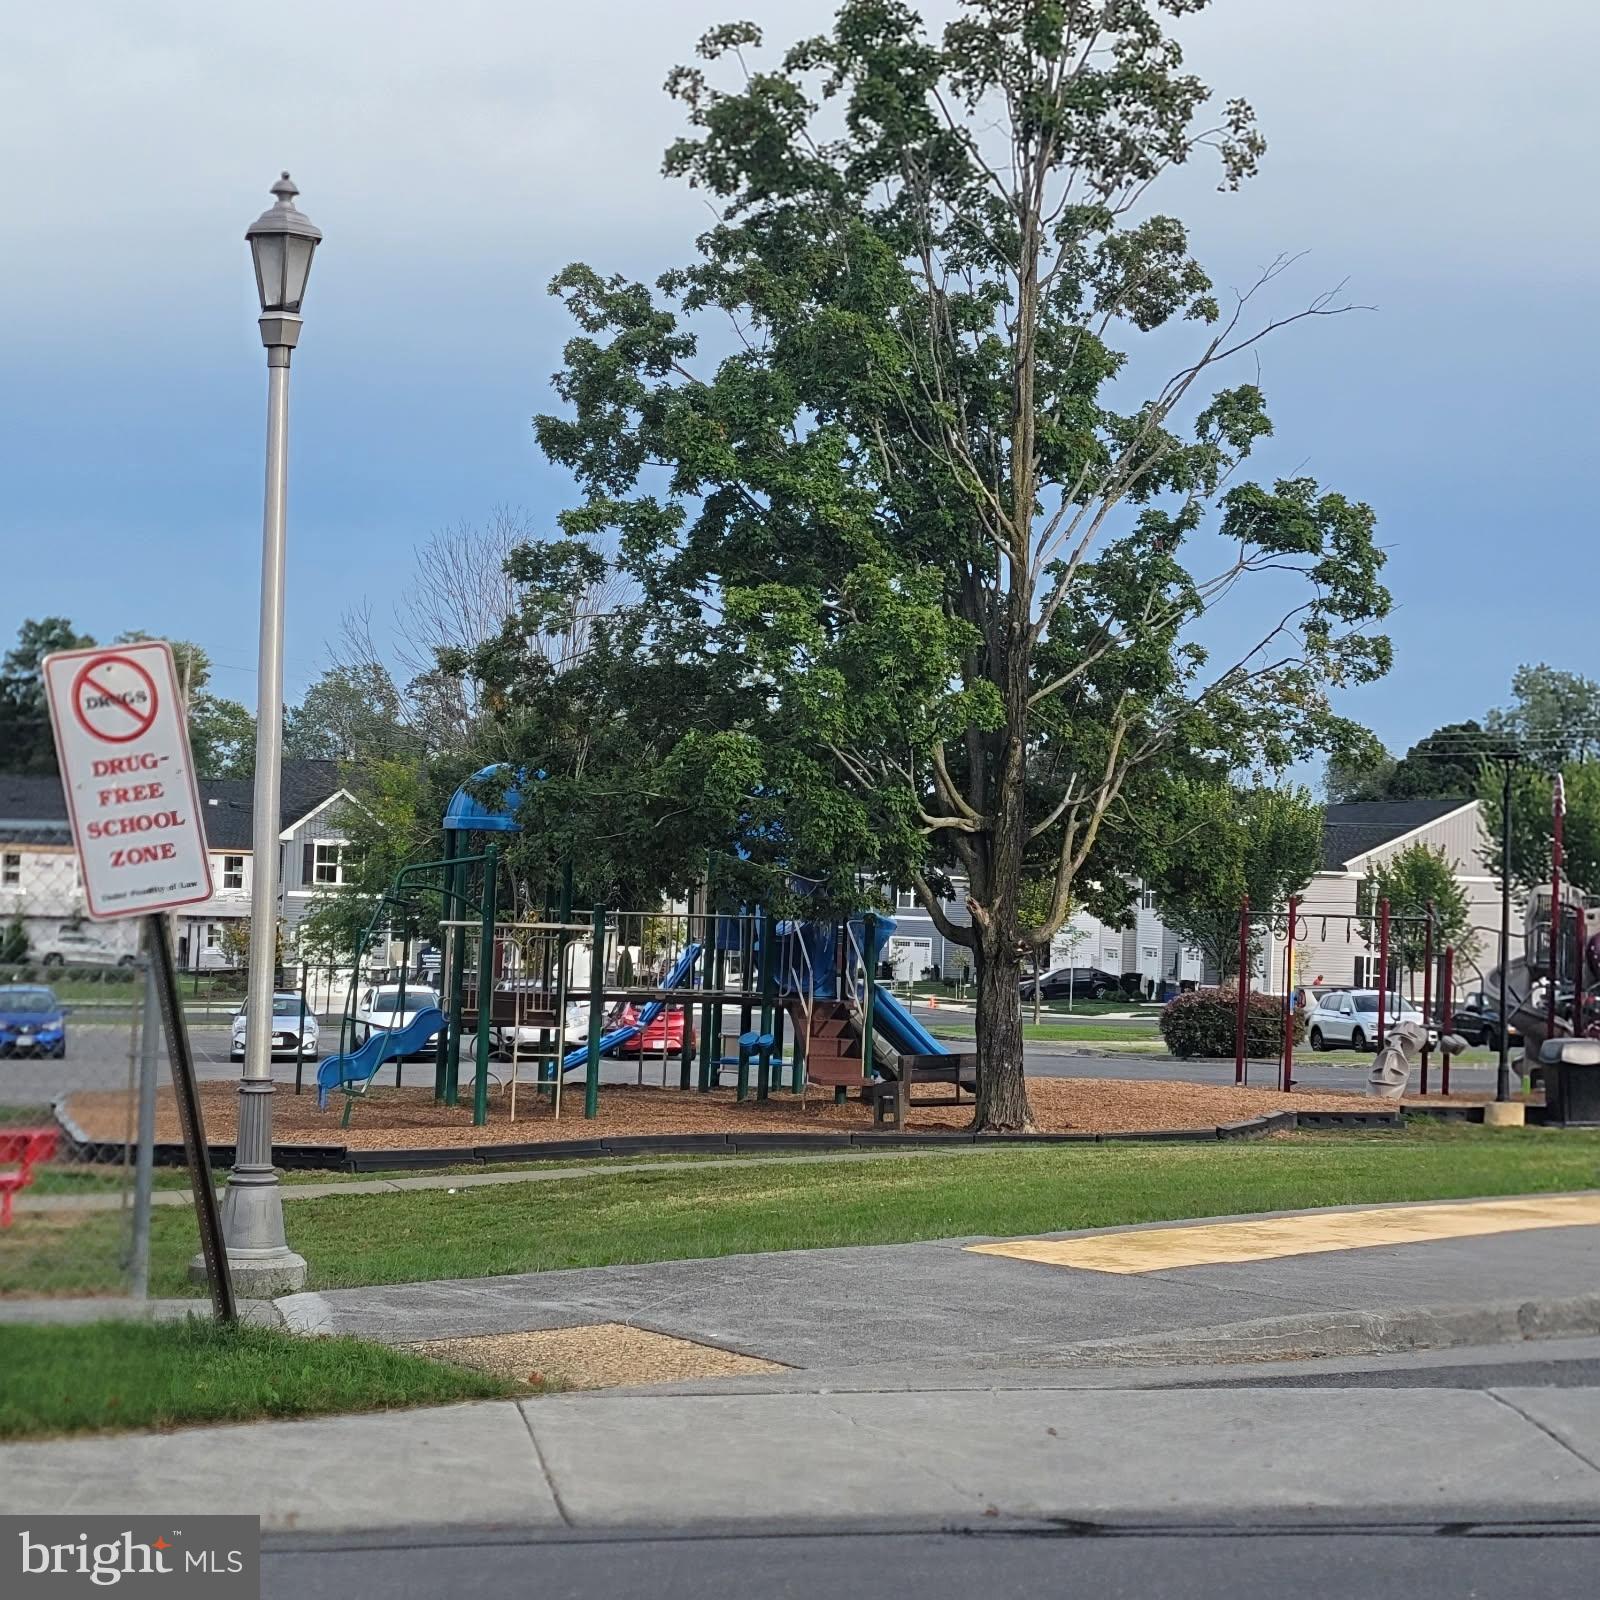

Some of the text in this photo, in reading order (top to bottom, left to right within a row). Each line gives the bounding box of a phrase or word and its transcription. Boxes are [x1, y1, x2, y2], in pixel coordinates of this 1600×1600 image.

[91, 753, 169, 778] DRUG-
[97, 782, 165, 808] FREE
[87, 810, 186, 840] SCHOOL
[110, 842, 177, 868] ZONE
